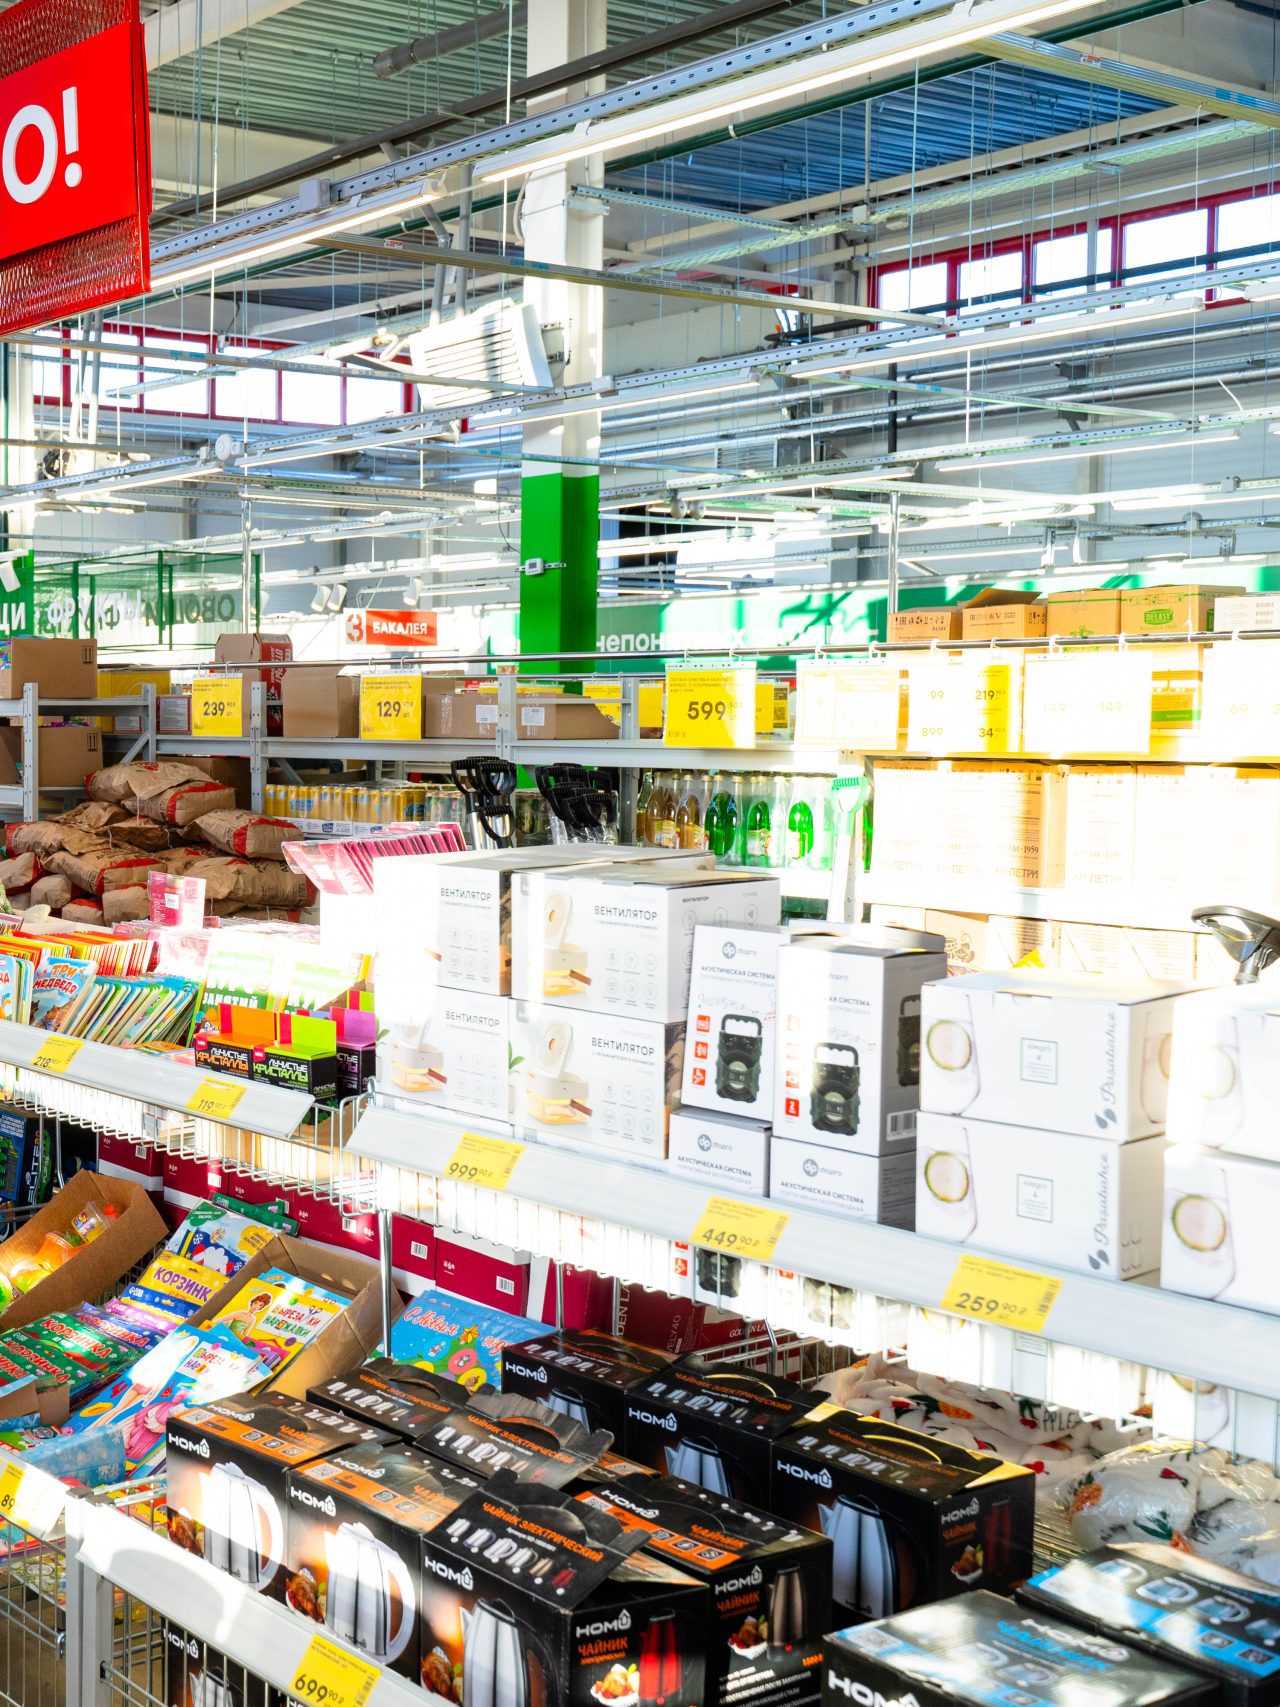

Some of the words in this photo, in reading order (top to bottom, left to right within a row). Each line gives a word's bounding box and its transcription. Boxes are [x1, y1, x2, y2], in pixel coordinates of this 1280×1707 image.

[47, 590, 142, 627] ФРУКТЫ
[372, 620, 428, 635] БАКАЛЕЯ
[975, 690, 995, 700] 219
[203, 701, 226, 717] 239
[376, 700, 401, 719] 129
[686, 701, 727, 721] 599
[978, 727, 994, 738] 34
[439, 887, 492, 902] ВЕНТИЛЯТОР
[593, 904, 659, 922] ВЕНТИЛЯТОР
[51, 963, 78, 979] ТРИ
[746, 970, 776, 980] СИСТЕМА
[33, 976, 79, 995] МЕДВЕДЯ
[202, 991, 259, 1009] ЗАНЯТИЙ
[838, 996, 871, 1007] СИСТЕМА
[444, 1010, 501, 1028] ВЕНТИЛЯТОР
[210, 1046, 248, 1064] ЛУЧИСТЫЕ
[591, 1036, 656, 1058] ВЕНТИЛЯТОР
[33, 1055, 50, 1068] 218
[195, 1050, 249, 1072] КРИСТАЛЛЫ
[268, 1056, 308, 1074] ЛУЧИСТЫЕ
[252, 1063, 309, 1083] КРИСТАЛЛЫ
[198, 1099, 215, 1112] 119
[448, 1162, 478, 1180] 999
[677, 1155, 723, 1171] АКУСТИЧЕСКАЯ
[723, 1164, 752, 1177] СИСТЕМА
[780, 1180, 832, 1197] АКУСТИЧЕСКАЯ
[832, 1191, 865, 1205] СИСТЕМА
[702, 1228, 738, 1247] 449
[153, 1266, 215, 1305] КОРЗИНК
[955, 1292, 999, 1315] 259
[1002, 1302, 1018, 1313] 90
[41, 1318, 113, 1359] КОРЗИНКА
[77, 1313, 150, 1347] КОРЗИНКА
[4, 1340, 70, 1383] КОРЗИНКА
[675, 1371, 713, 1391] ЧАЙНИК
[712, 1382, 794, 1411] ЭЛЕКТРИЧЕСКИЙ
[467, 1414, 502, 1435] ЧАЙНИК
[500, 1429, 577, 1465] ЭЛЕКТРИЧЕСКИЙ
[0, 1494, 16, 1510] 89
[482, 1501, 521, 1527] ЧАЙНИК
[519, 1517, 605, 1563] ЭЛЕКТРИЧЕСКИЙ
[716, 1590, 761, 1612] ЧАЙНИК
[577, 1636, 629, 1657] ЧАЙНИК
[294, 1673, 329, 1704] 699
